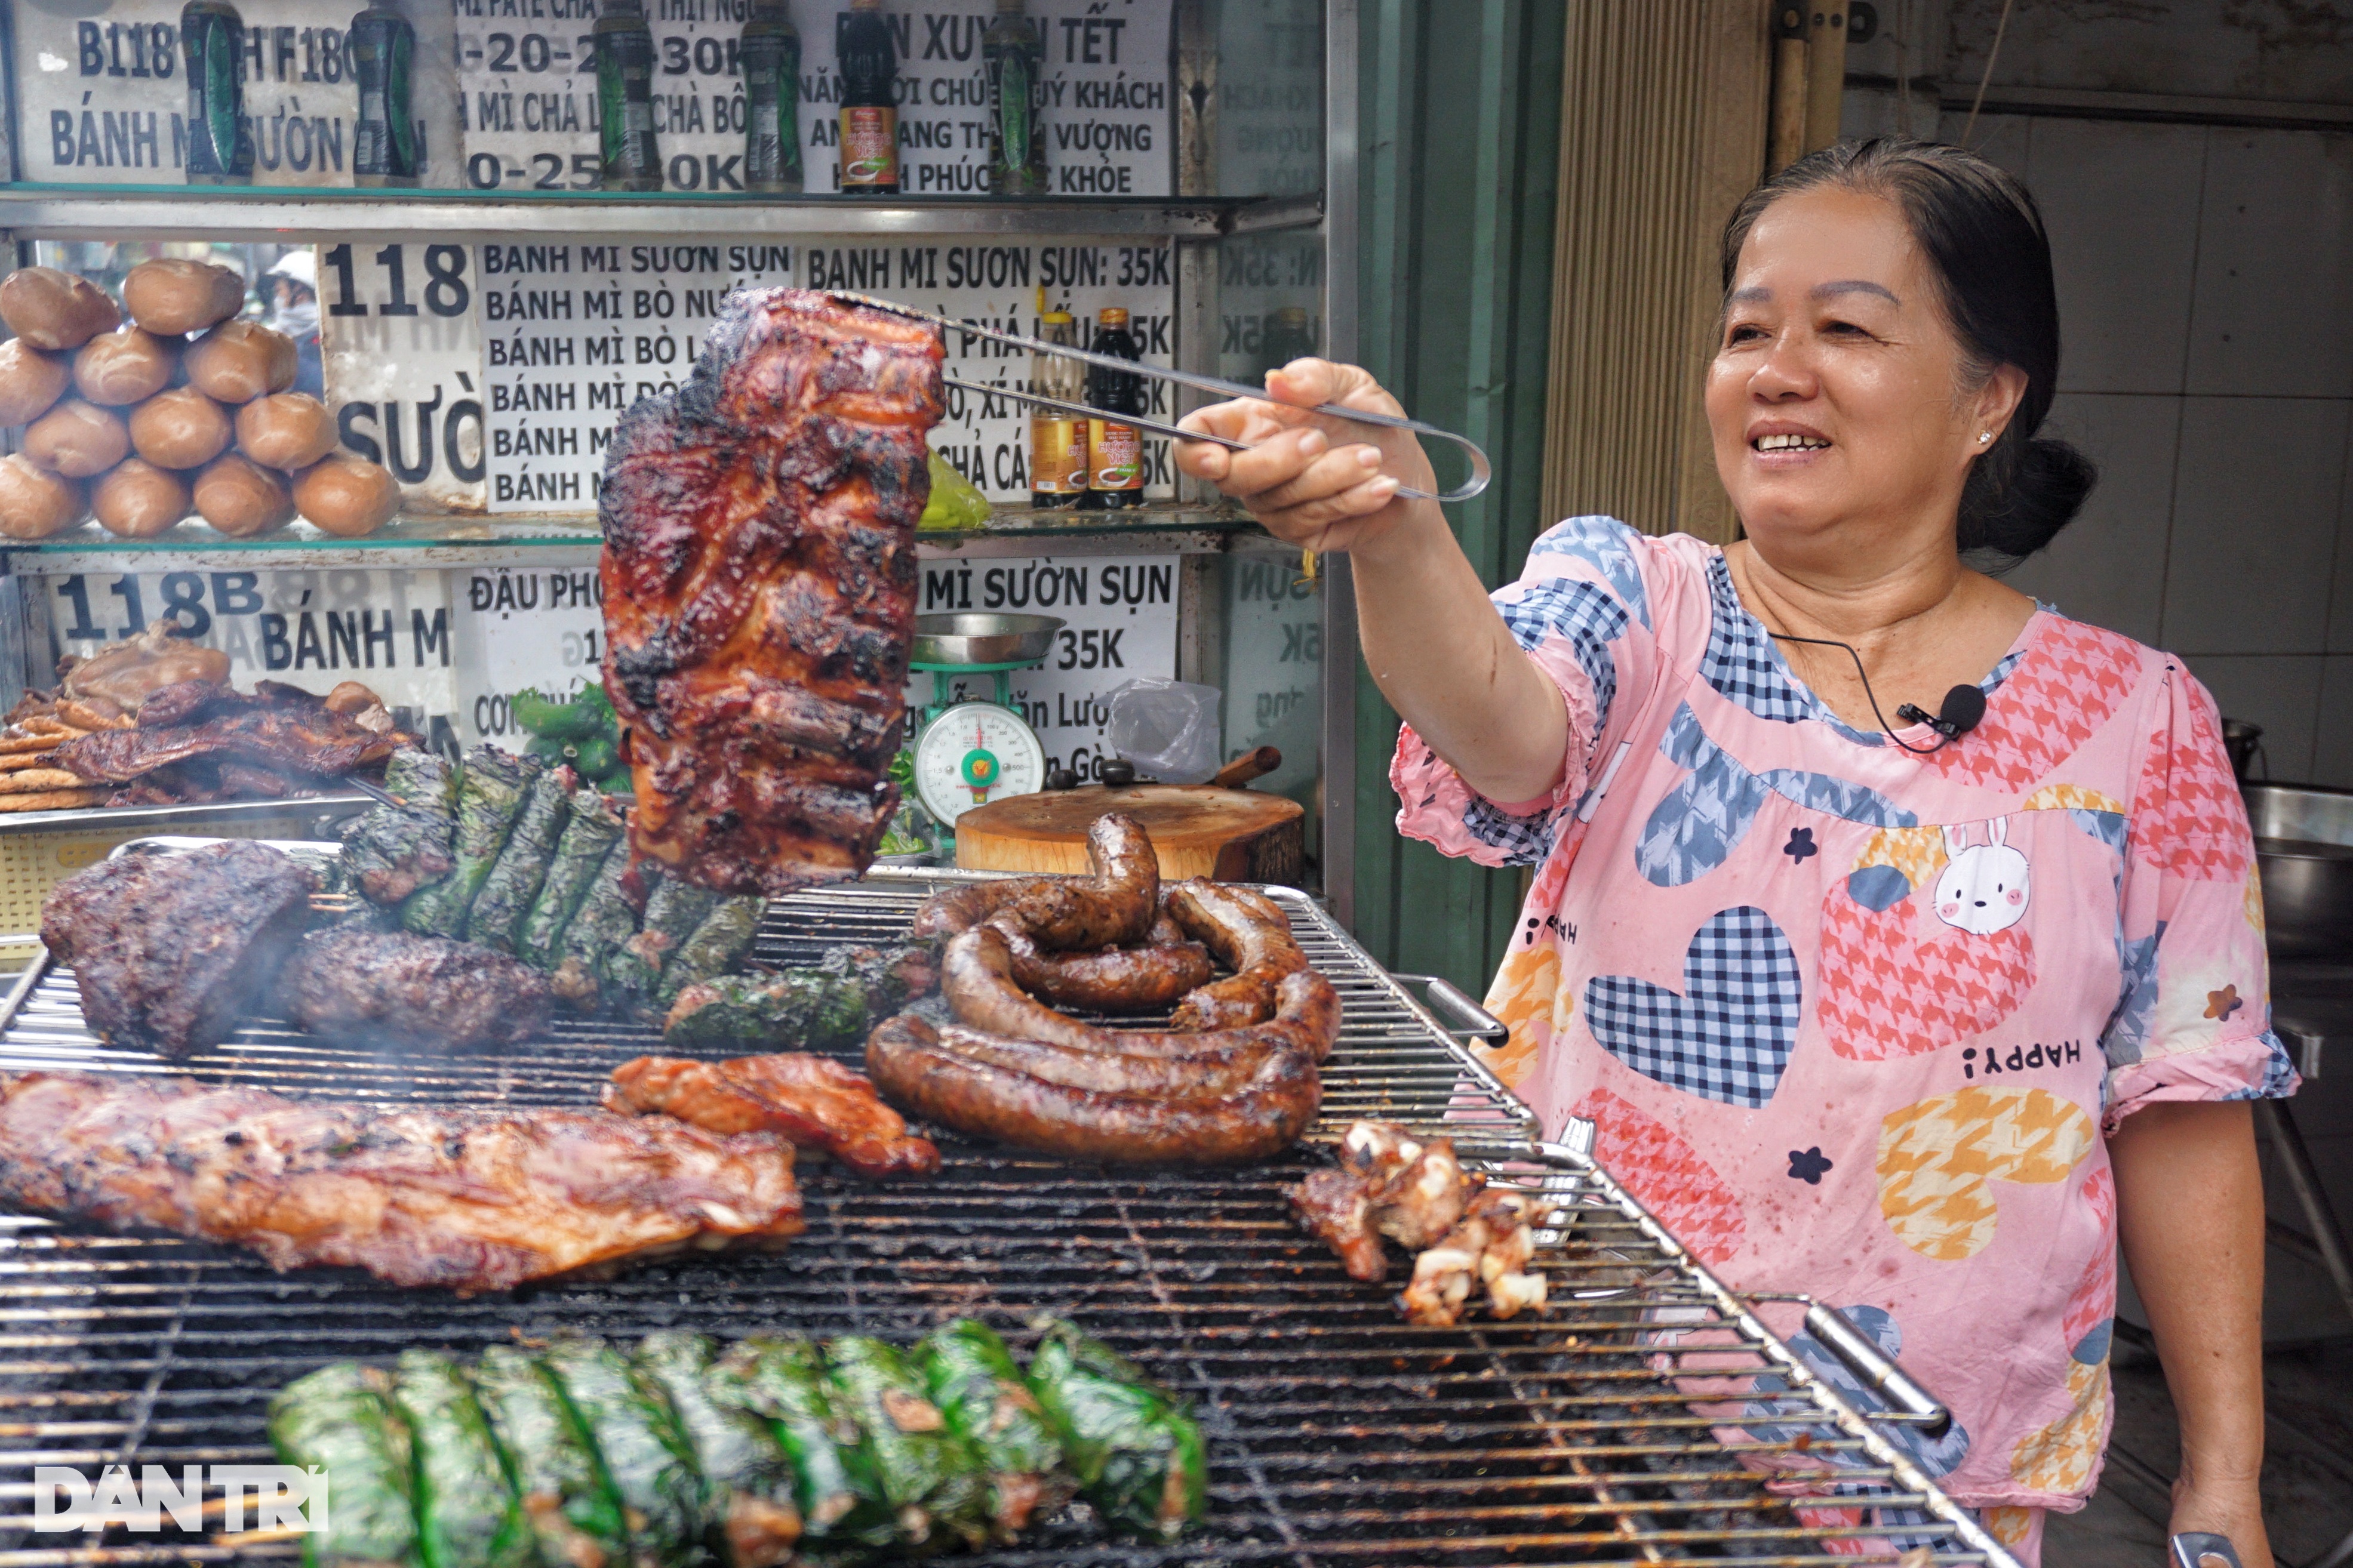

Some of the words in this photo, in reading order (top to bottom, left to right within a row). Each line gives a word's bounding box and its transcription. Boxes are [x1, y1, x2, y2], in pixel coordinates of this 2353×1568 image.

[77, 21, 174, 79] B118
[1060, 2, 1126, 64] TẾT
[930, 69, 985, 106] CHÚ
[1075, 70, 1164, 109] KHÁCH
[50, 90, 159, 168] BÁNH
[1055, 118, 1152, 158] VƯỢNG
[1060, 154, 1131, 193] KHỎE
[325, 244, 469, 318] 118
[1117, 247, 1170, 287] 35K
[485, 279, 572, 321] BÁNH
[583, 279, 623, 319] MÌ
[633, 279, 675, 319] BÒ
[488, 326, 575, 366] BÁNH
[585, 325, 624, 365] MÌ
[635, 325, 676, 365] BÒ
[490, 373, 576, 412] BÁNH
[587, 371, 626, 410] MÌ
[493, 418, 578, 457] BÁNH
[495, 463, 580, 502] BÁNH
[926, 559, 973, 610] MÌ
[983, 556, 1088, 608] SƯỜN
[1099, 564, 1172, 615] SỤN
[259, 589, 395, 671] BÁNH
[1057, 628, 1125, 671] 35K
[1962, 1039, 2081, 1079] HAPPY!
